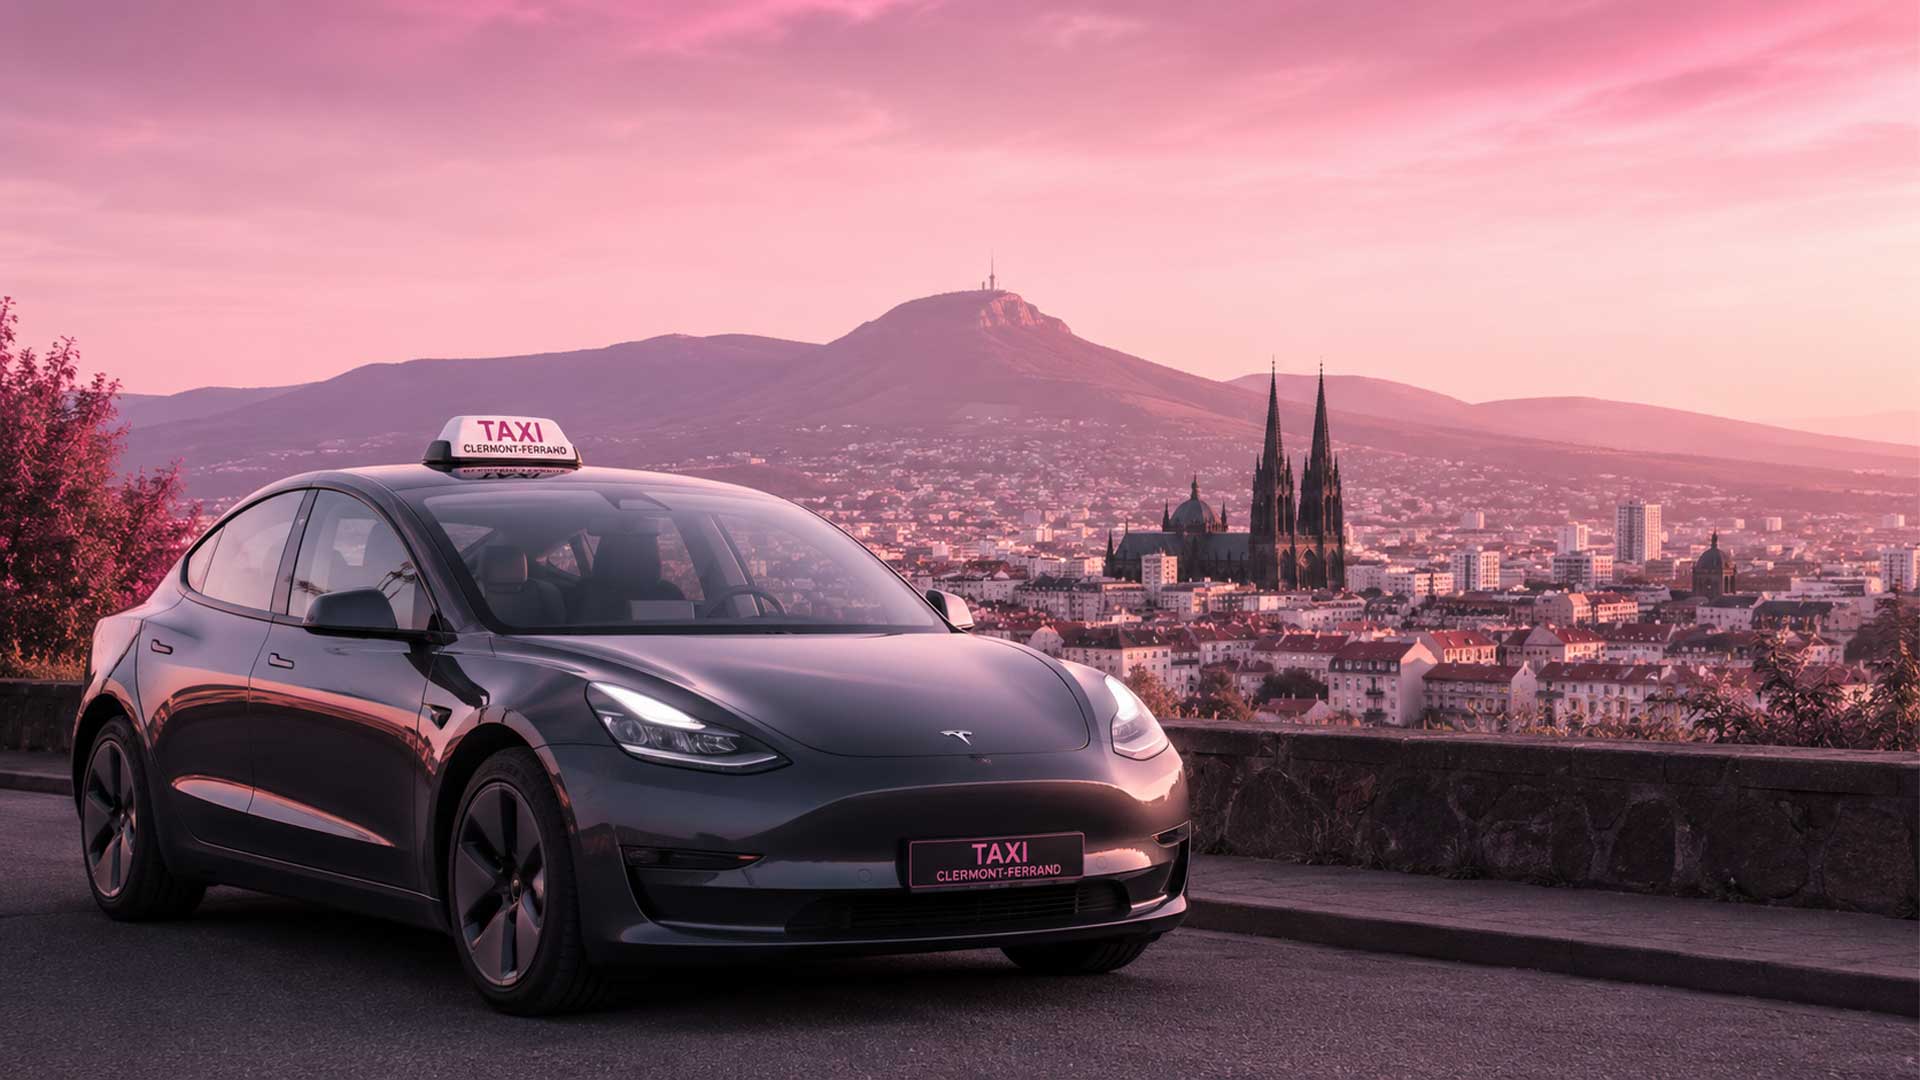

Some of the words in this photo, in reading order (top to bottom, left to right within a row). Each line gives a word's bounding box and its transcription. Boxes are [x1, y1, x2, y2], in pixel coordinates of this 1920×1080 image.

[477, 420, 543, 442] TAXI
[972, 841, 1028, 865] TAXI
[936, 864, 1062, 882] CLERMONT-FERRAND
